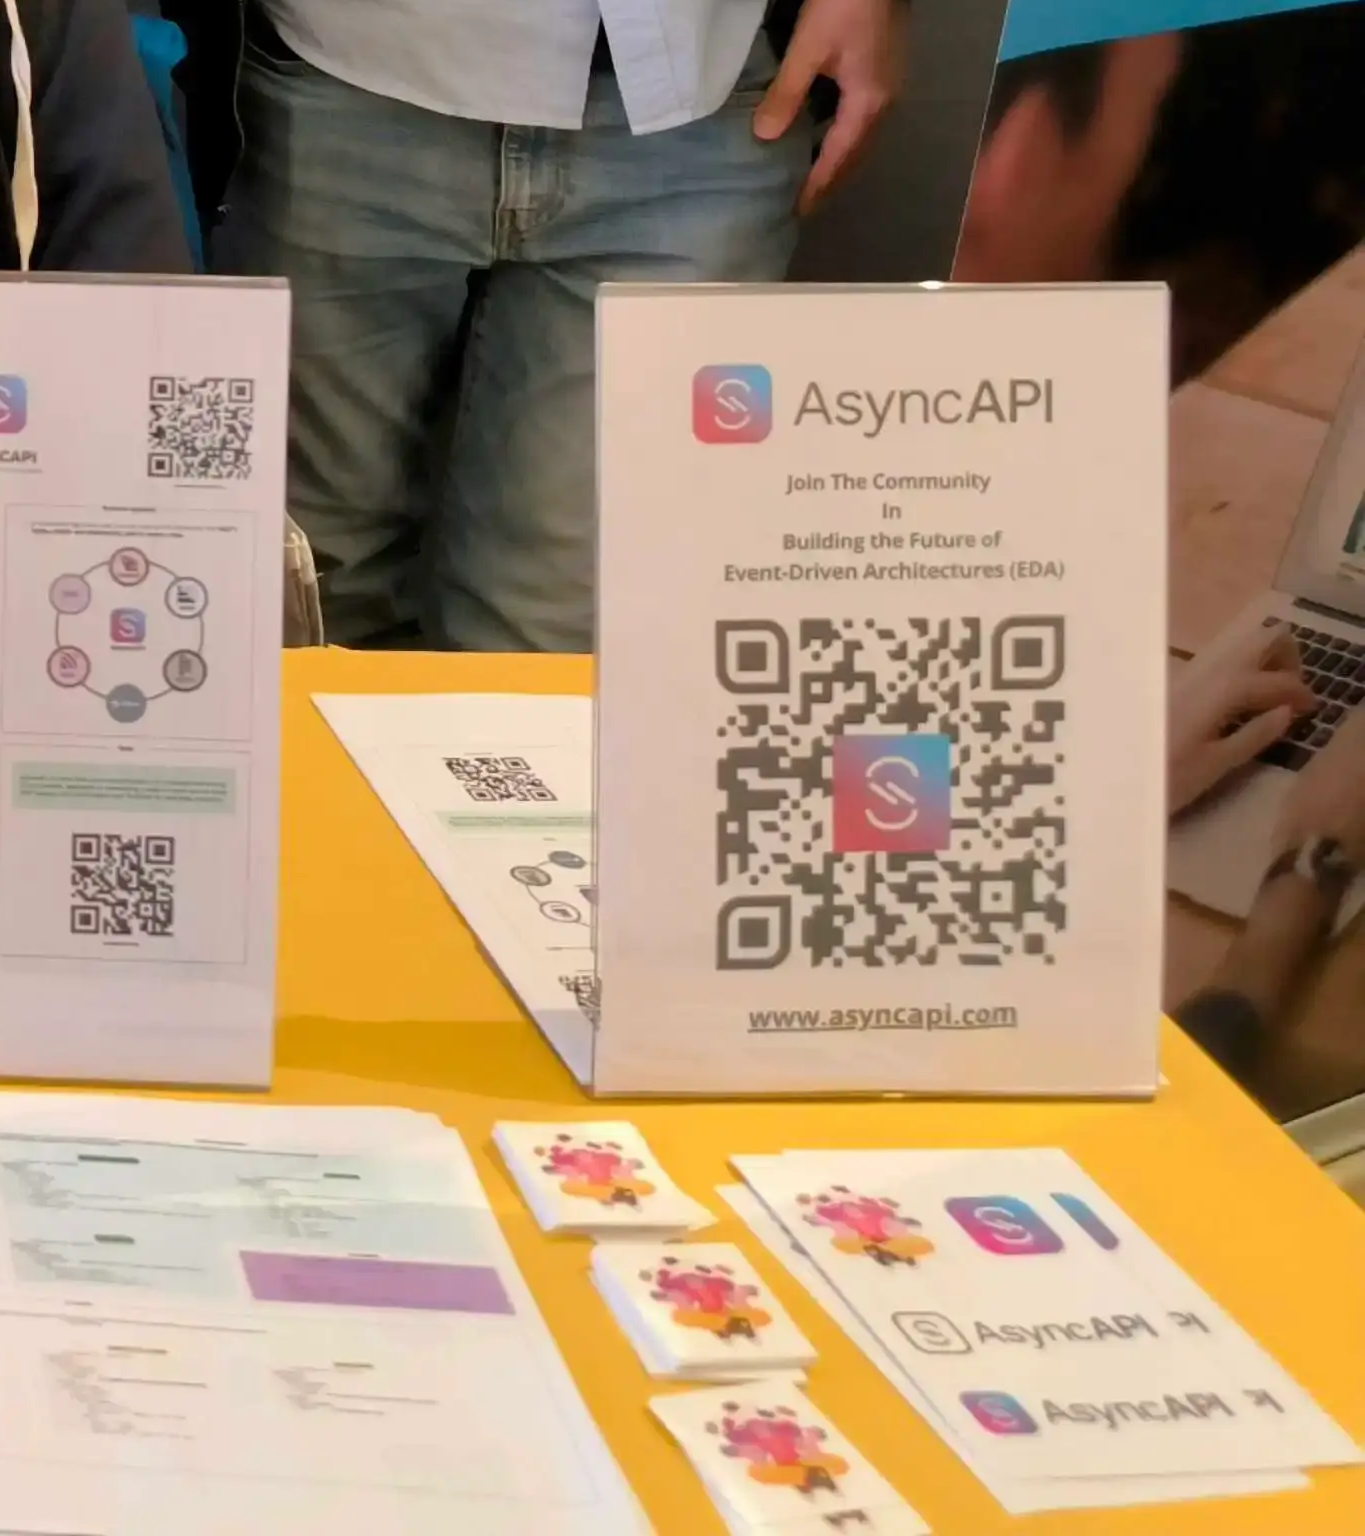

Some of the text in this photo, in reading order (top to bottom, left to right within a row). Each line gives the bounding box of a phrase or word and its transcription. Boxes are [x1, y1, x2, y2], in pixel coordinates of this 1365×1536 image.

[793, 378, 1054, 437] AsyncAPI
[785, 471, 992, 495] Join The Community
[882, 502, 902, 520] In
[782, 530, 1003, 554] Building the Future of
[723, 559, 1065, 583] Event-Driven Architectures (EDA)
[748, 1000, 1017, 1033] www.asyncapi.com
[974, 1313, 1159, 1349] AsyncAPI
[1042, 1392, 1235, 1430] AsyncAPI
